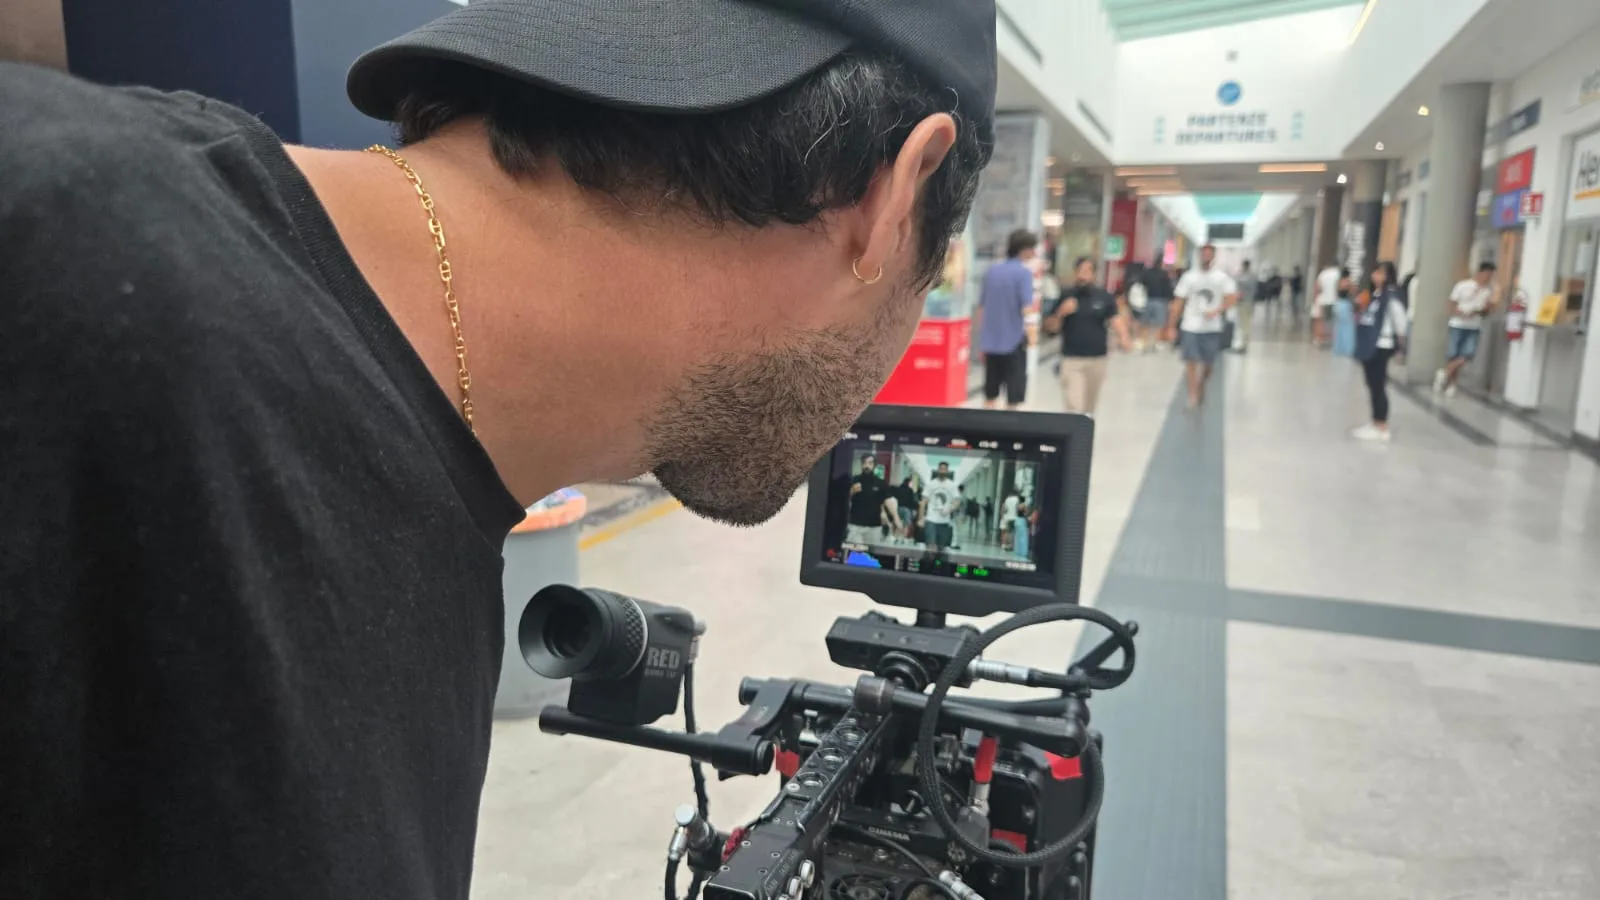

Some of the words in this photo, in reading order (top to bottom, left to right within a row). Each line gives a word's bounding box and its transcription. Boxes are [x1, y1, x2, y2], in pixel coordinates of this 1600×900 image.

[1187, 112, 1267, 126] PARTENZE
[1175, 129, 1277, 144] DEPARTURES
[647, 647, 680, 669] RED
